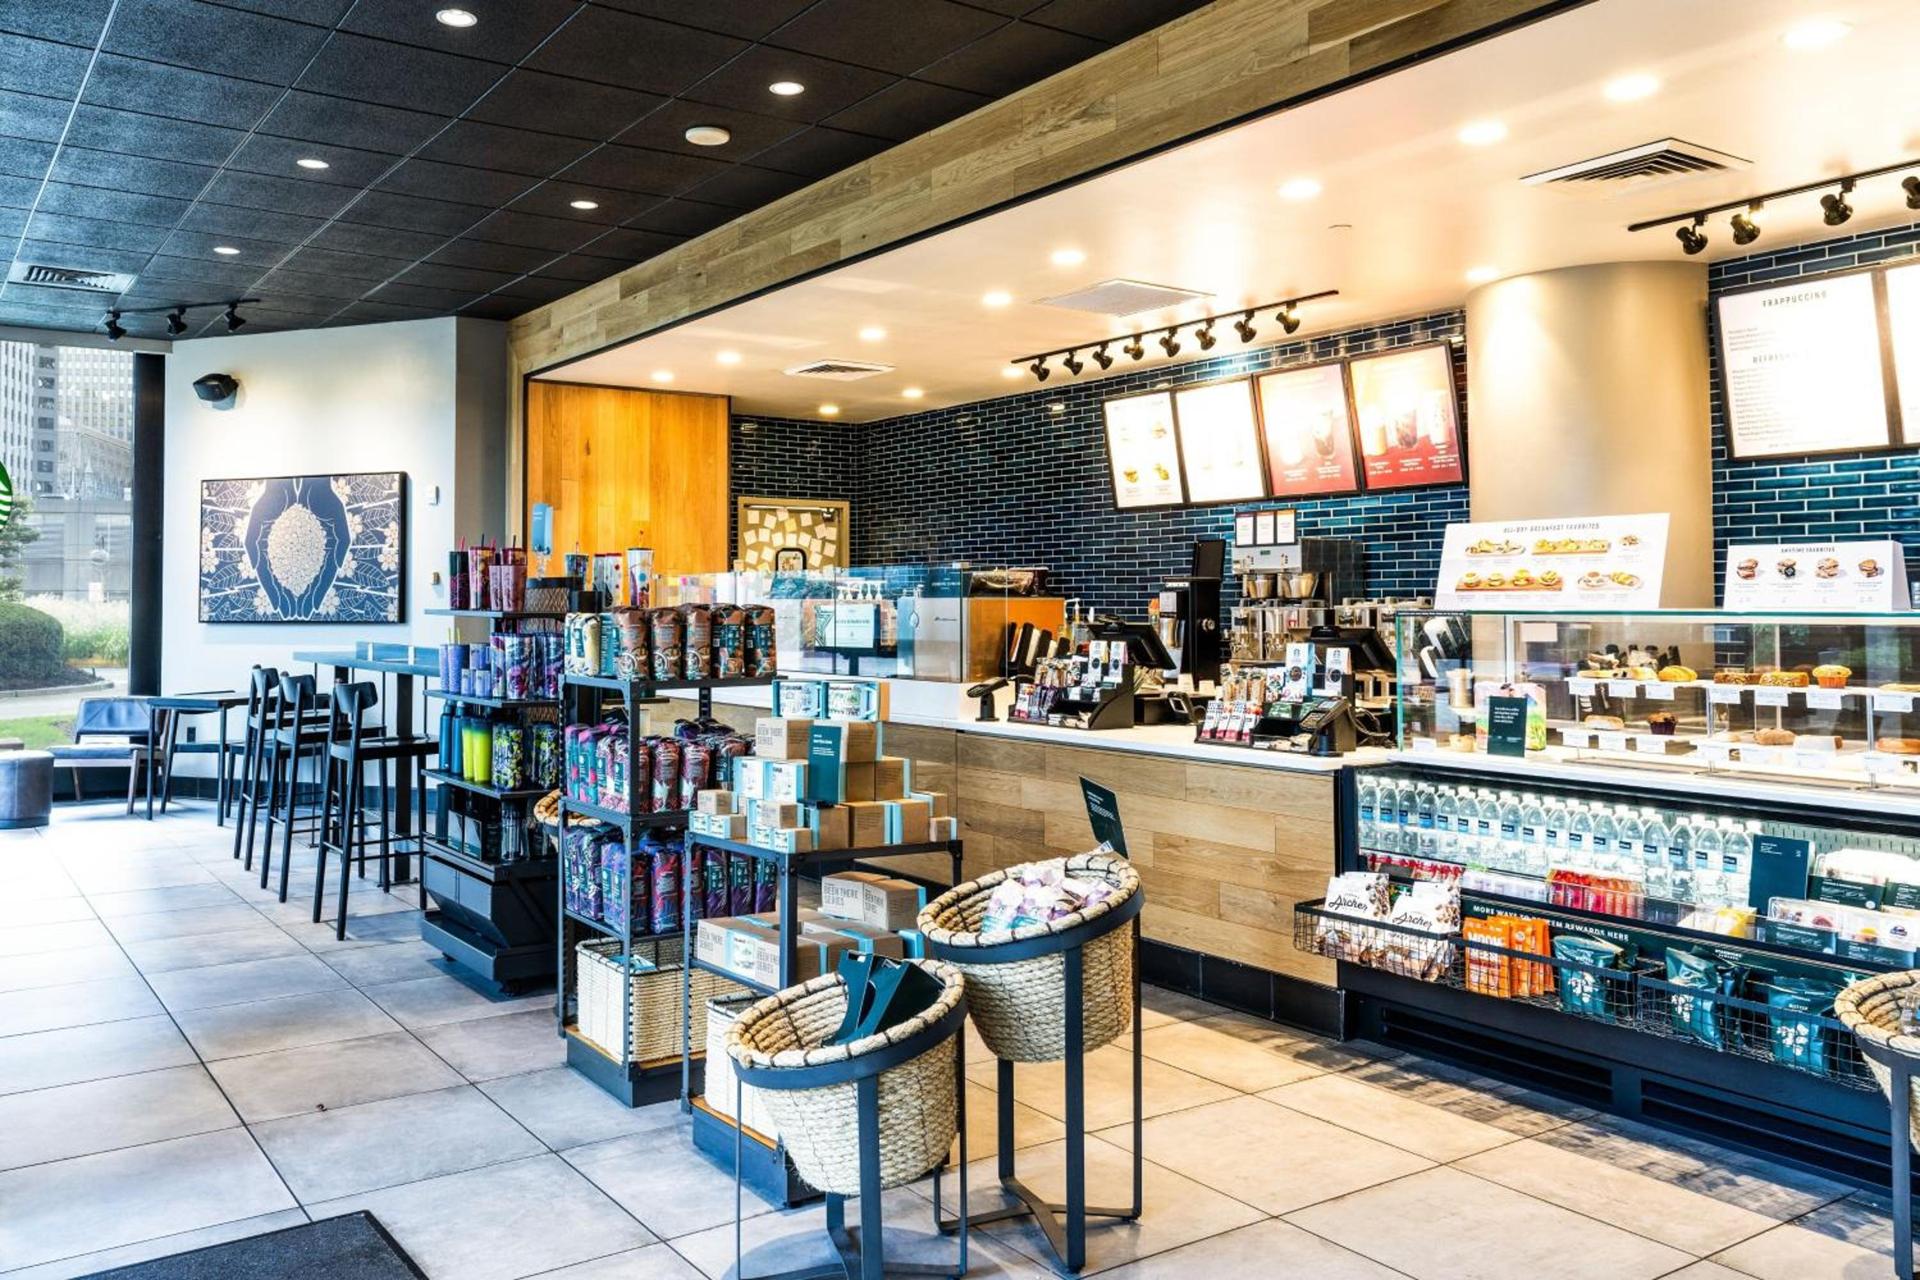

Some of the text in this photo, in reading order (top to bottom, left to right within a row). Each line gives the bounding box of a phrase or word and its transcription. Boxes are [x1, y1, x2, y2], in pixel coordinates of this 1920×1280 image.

[1762, 290, 1828, 308] FRAPPUCCINO
[1328, 894, 1369, 912] Archer
[1392, 912, 1433, 930] Archer
[1473, 905, 1495, 915] MORE
[1565, 921, 1606, 937] REWARDS
[1607, 930, 1630, 942] HERE
